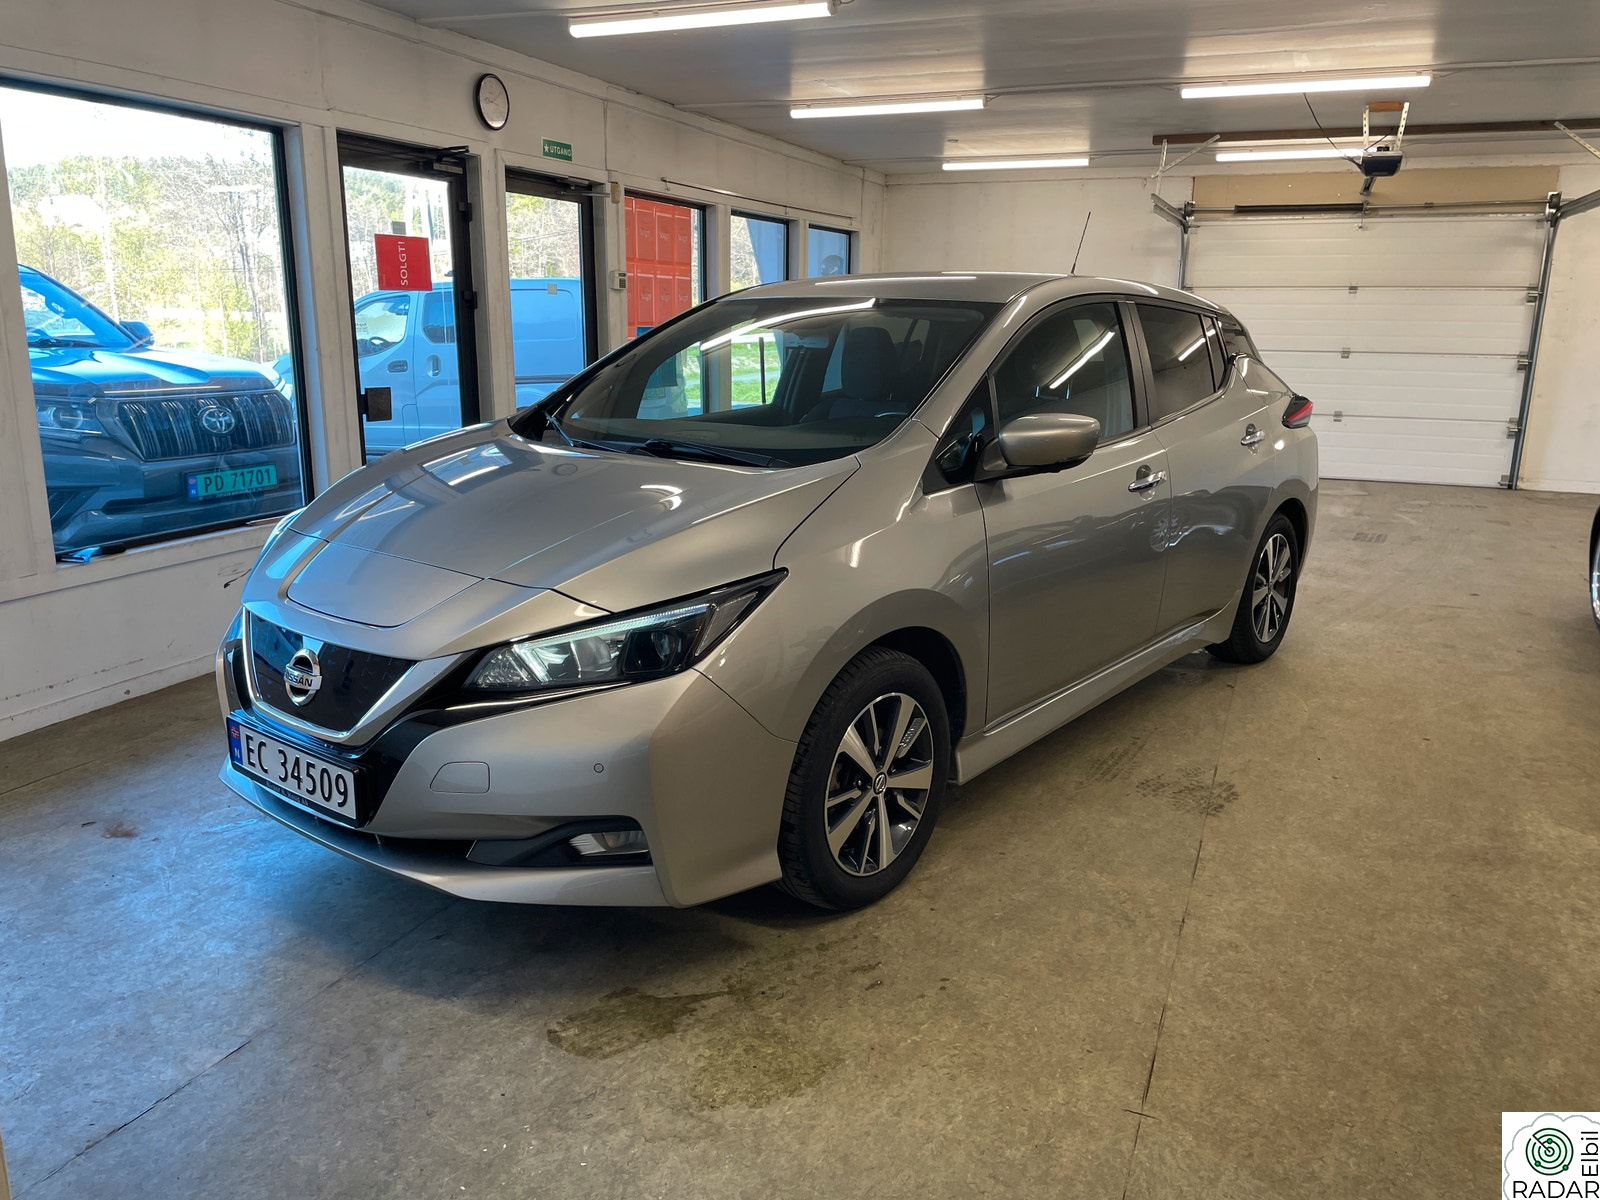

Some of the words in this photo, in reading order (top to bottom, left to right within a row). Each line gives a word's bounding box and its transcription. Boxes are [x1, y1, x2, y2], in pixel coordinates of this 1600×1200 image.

[397, 241, 408, 286] SOLGT!
[204, 475, 225, 493] PD
[230, 468, 271, 489] 71701
[285, 671, 313, 687] NISSAN
[245, 733, 268, 774] EC
[278, 748, 348, 808] 34509
